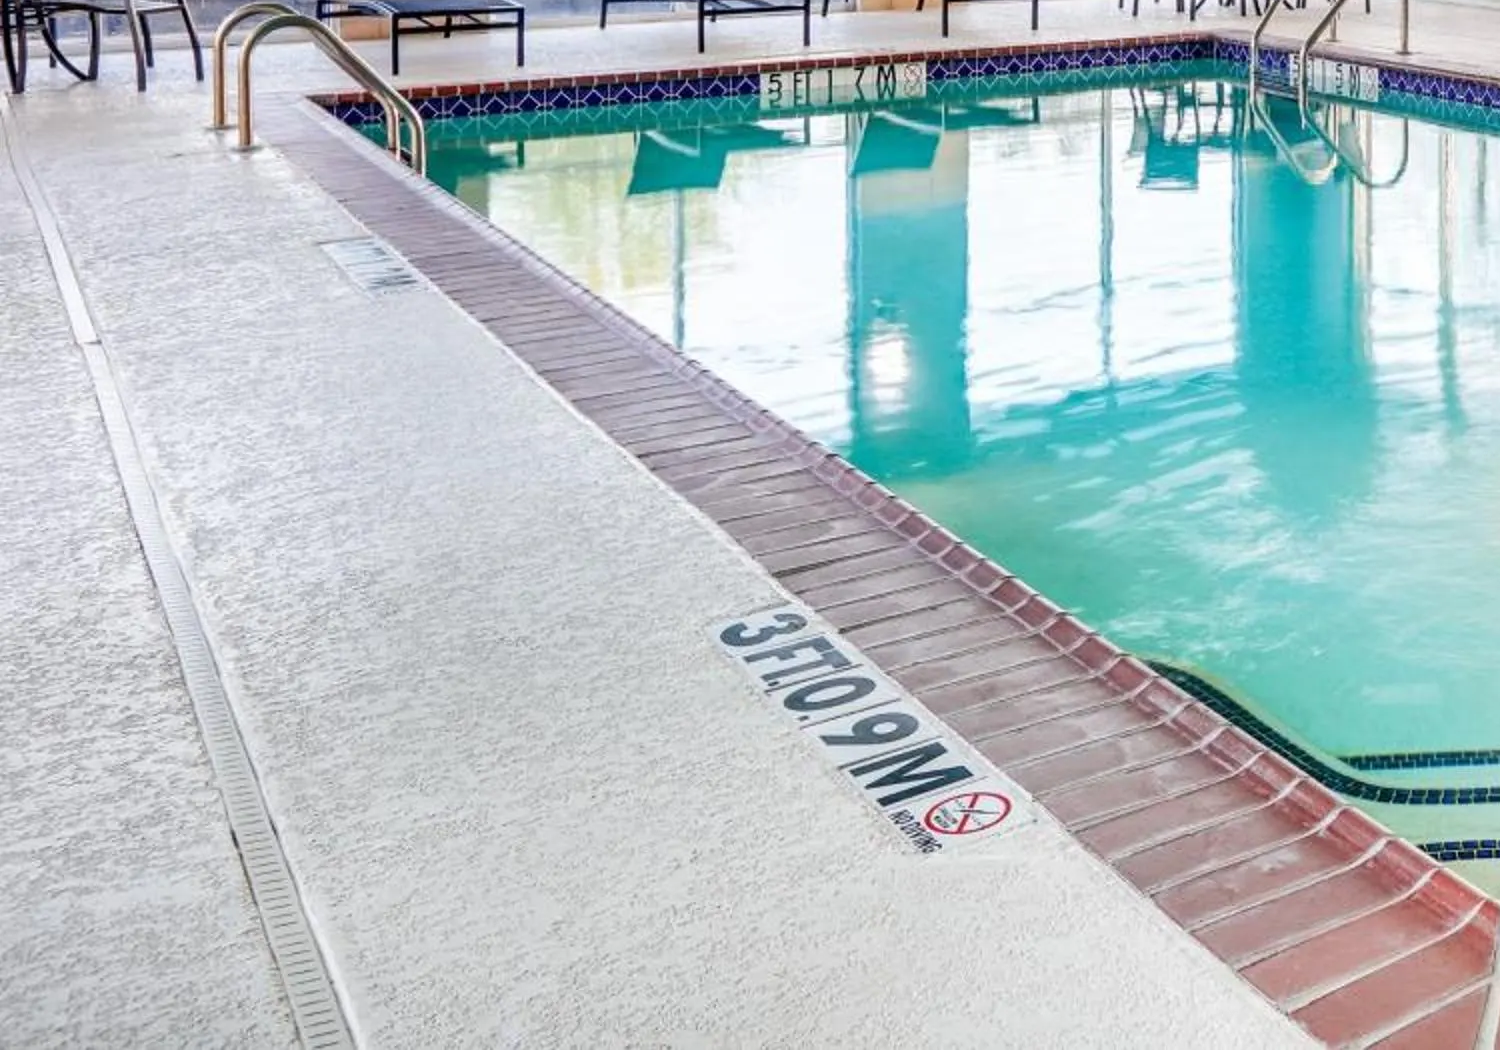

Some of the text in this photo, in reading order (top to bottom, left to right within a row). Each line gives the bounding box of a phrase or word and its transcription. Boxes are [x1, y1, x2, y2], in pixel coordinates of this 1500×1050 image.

[768, 74, 783, 94] 5
[877, 65, 896, 86] M
[719, 613, 808, 648] 3
